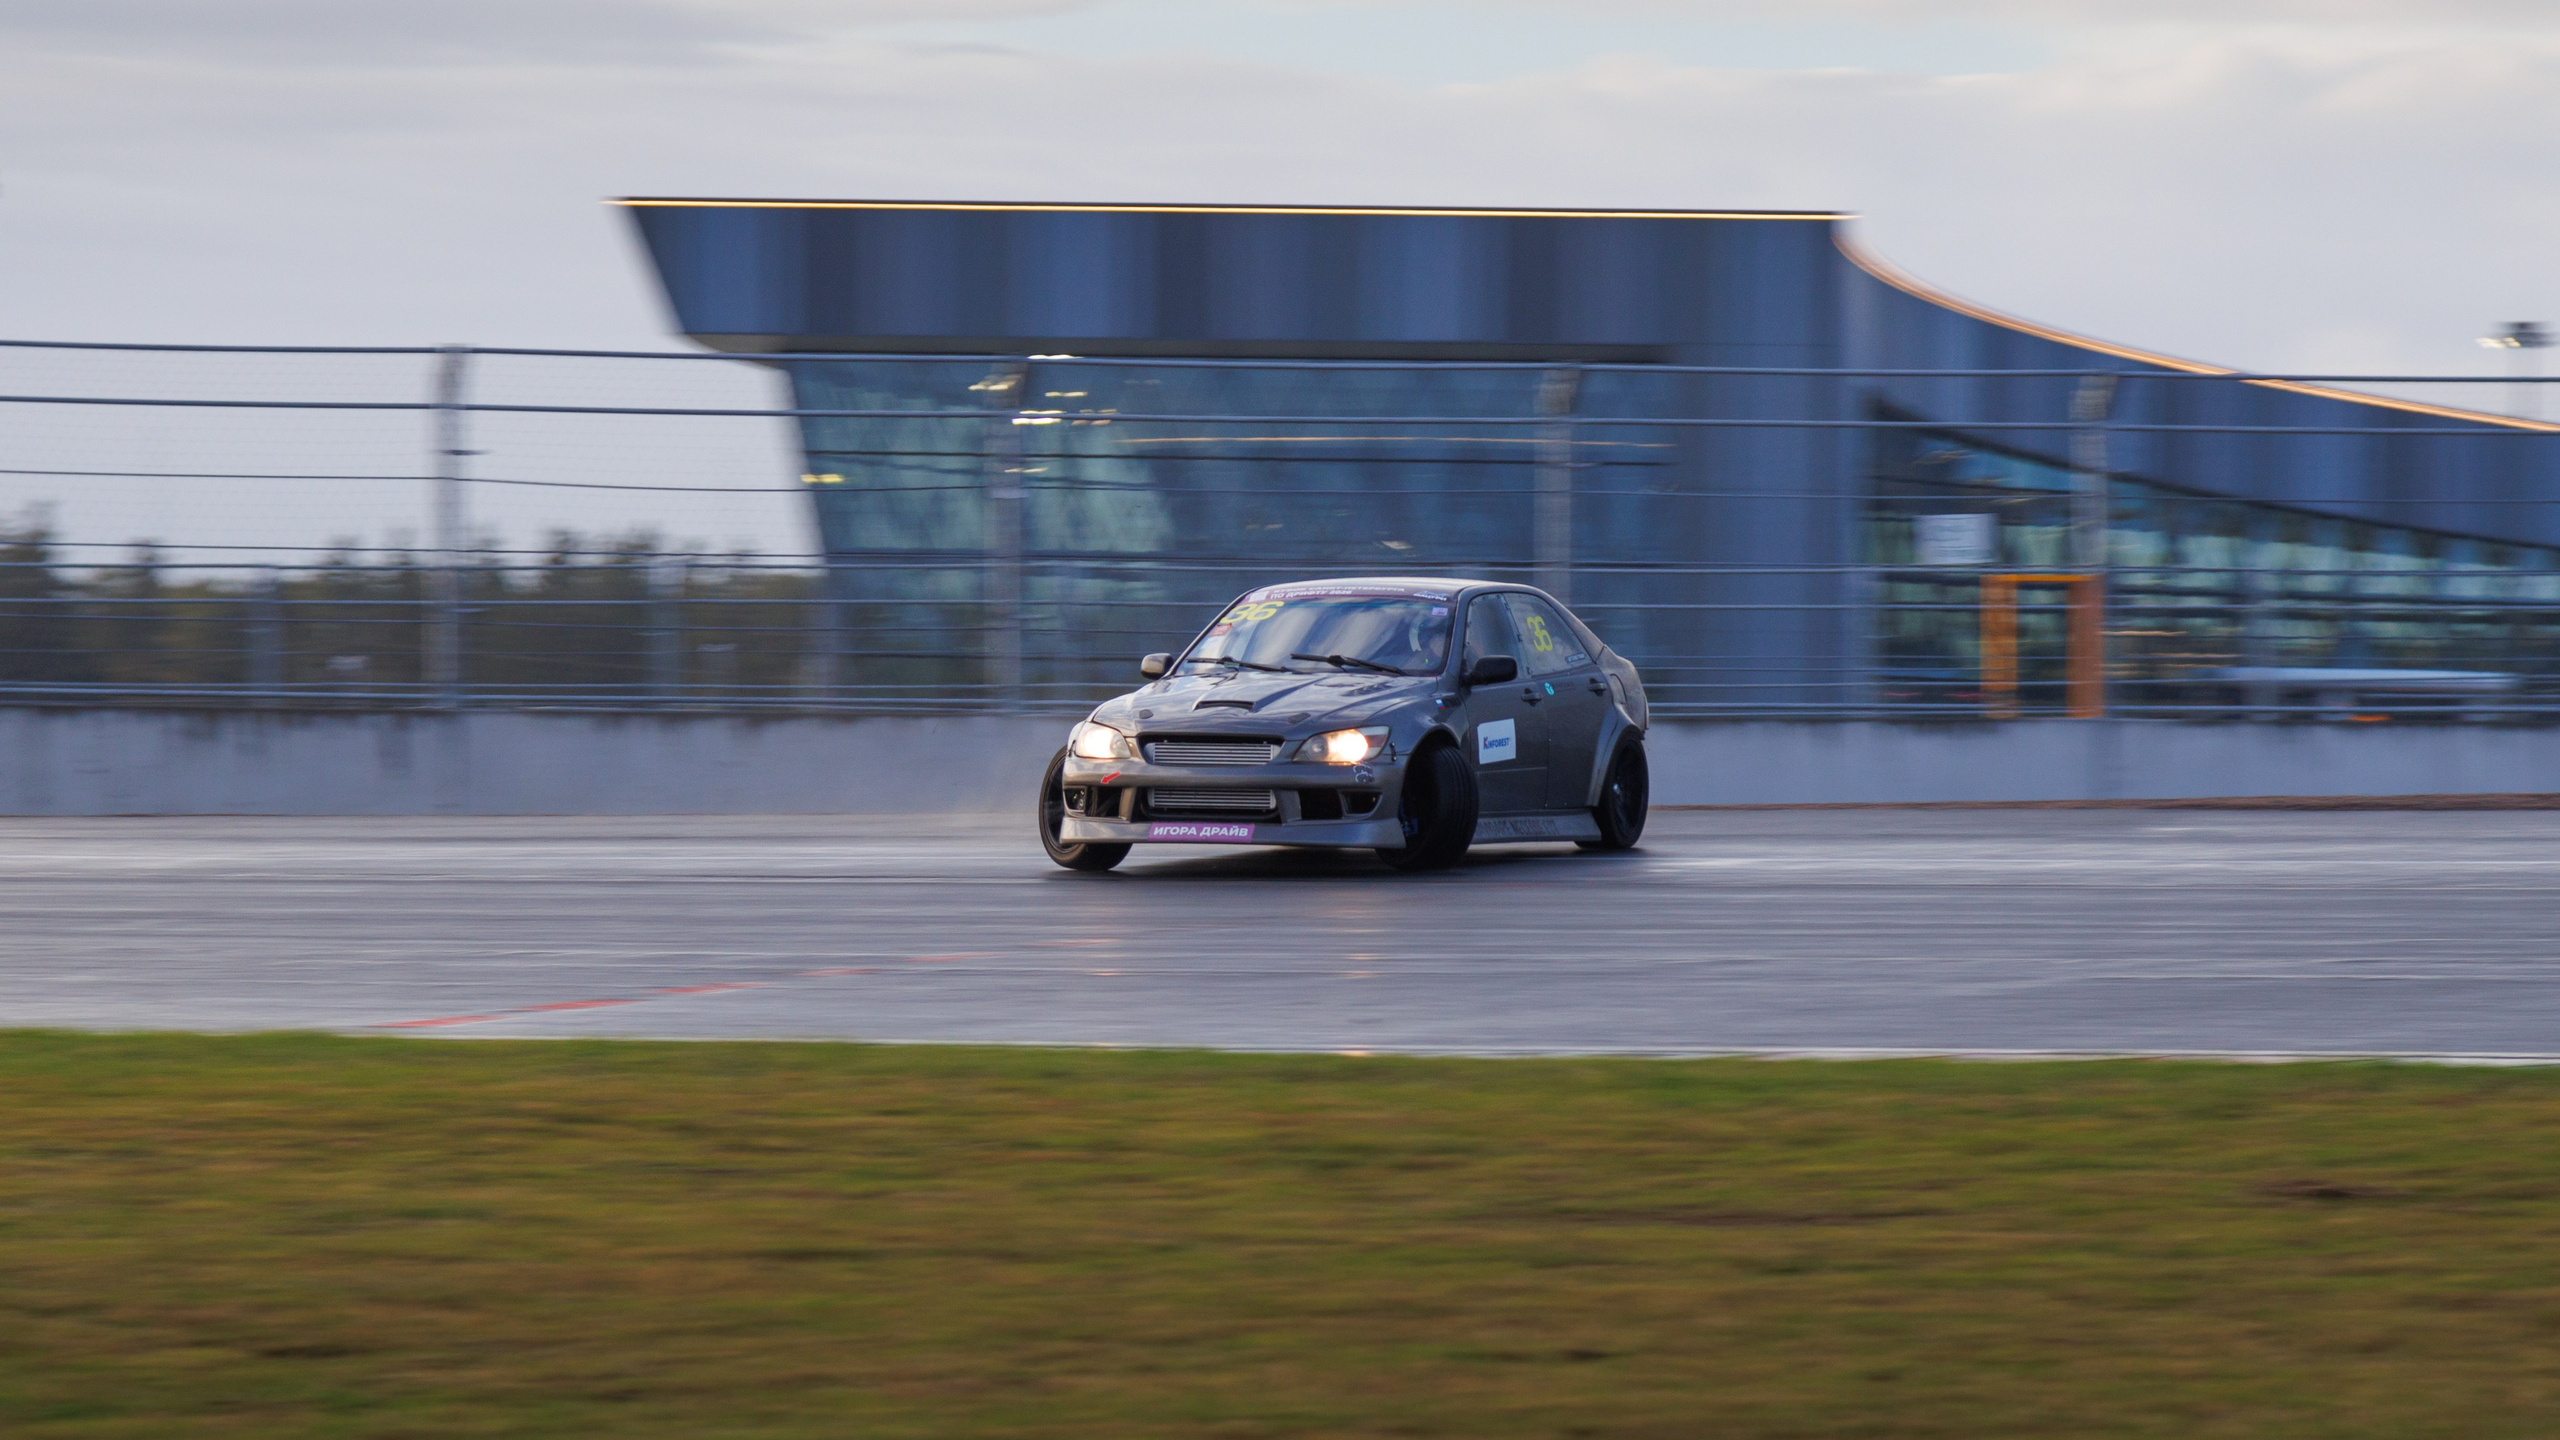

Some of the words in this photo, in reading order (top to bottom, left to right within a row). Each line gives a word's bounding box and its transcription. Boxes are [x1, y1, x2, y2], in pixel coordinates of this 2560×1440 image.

[1270, 592, 1285, 600] ПО
[1286, 589, 1328, 598] ДРИФТУ
[1220, 601, 1285, 624] 36
[1526, 615, 1554, 652] 36
[1153, 826, 1197, 836] ИГОРА
[1200, 825, 1249, 837] ДРАЙВ
